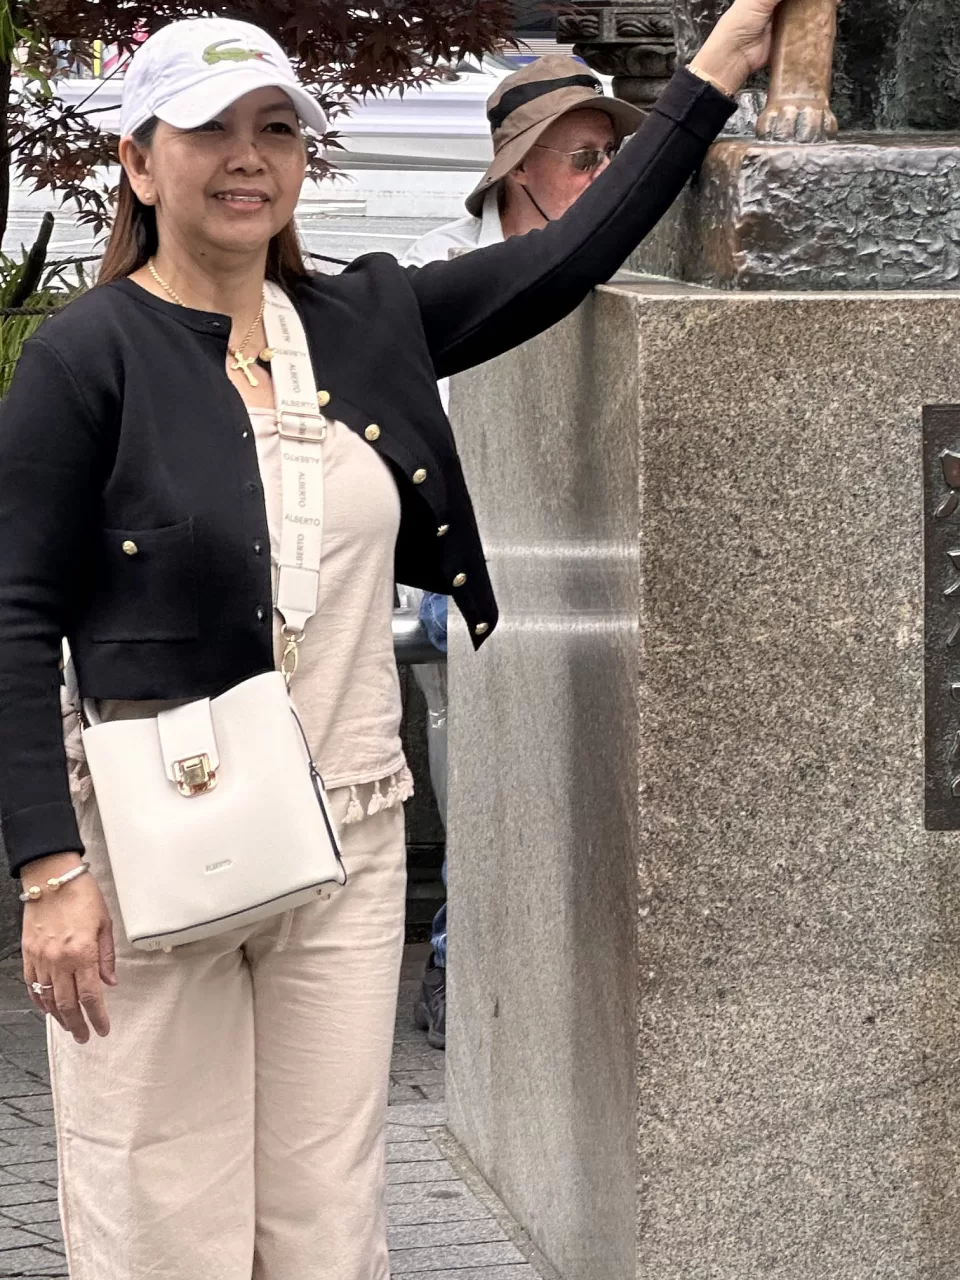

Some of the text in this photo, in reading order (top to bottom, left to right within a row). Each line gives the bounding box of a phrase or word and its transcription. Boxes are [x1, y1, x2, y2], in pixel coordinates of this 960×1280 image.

[281, 399, 317, 410] ALBERTO
[283, 452, 320, 465] ALBERTO
[298, 471, 307, 508] ALBERTO
[284, 513, 321, 527] ALBERTO
[296, 533, 305, 569] LBERTO
